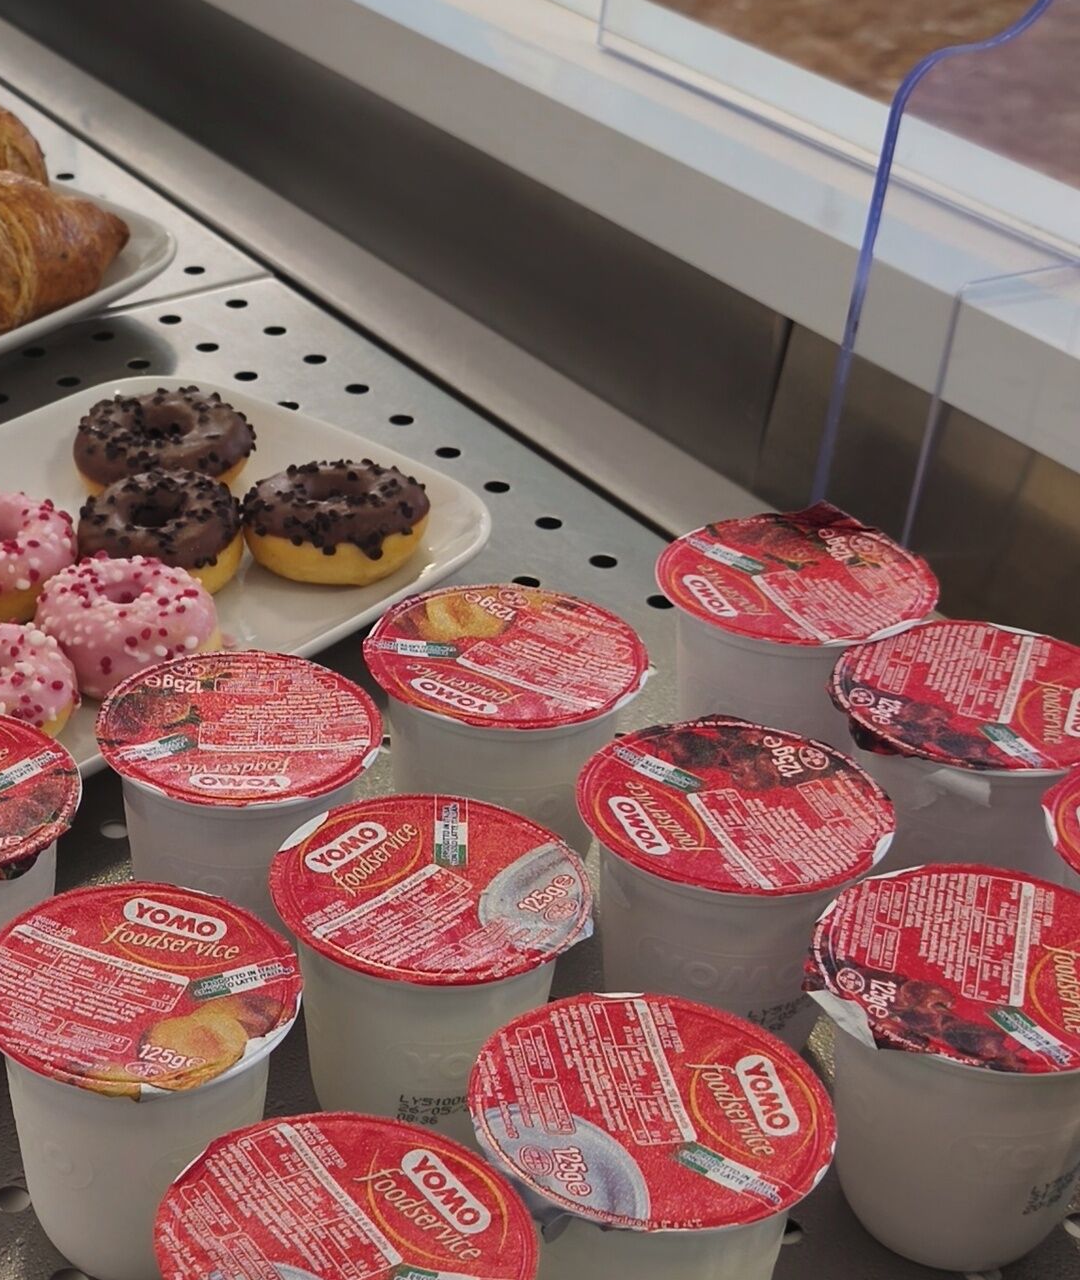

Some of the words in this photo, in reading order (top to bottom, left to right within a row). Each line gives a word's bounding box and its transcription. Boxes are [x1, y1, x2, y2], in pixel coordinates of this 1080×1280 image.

[420, 683, 489, 713] YOMO
[200, 776, 282, 788] YOMO
[312, 825, 380, 868] YOMO
[617, 801, 663, 851] YOMO
[332, 821, 418, 898] foodservice
[101, 922, 241, 960] foodservice
[136, 902, 217, 937] YOMO
[684, 1061, 777, 1157] foodservice
[744, 1059, 791, 1131] YOMO
[353, 1167, 484, 1261] foodservice
[412, 1153, 482, 1226] YOMO
